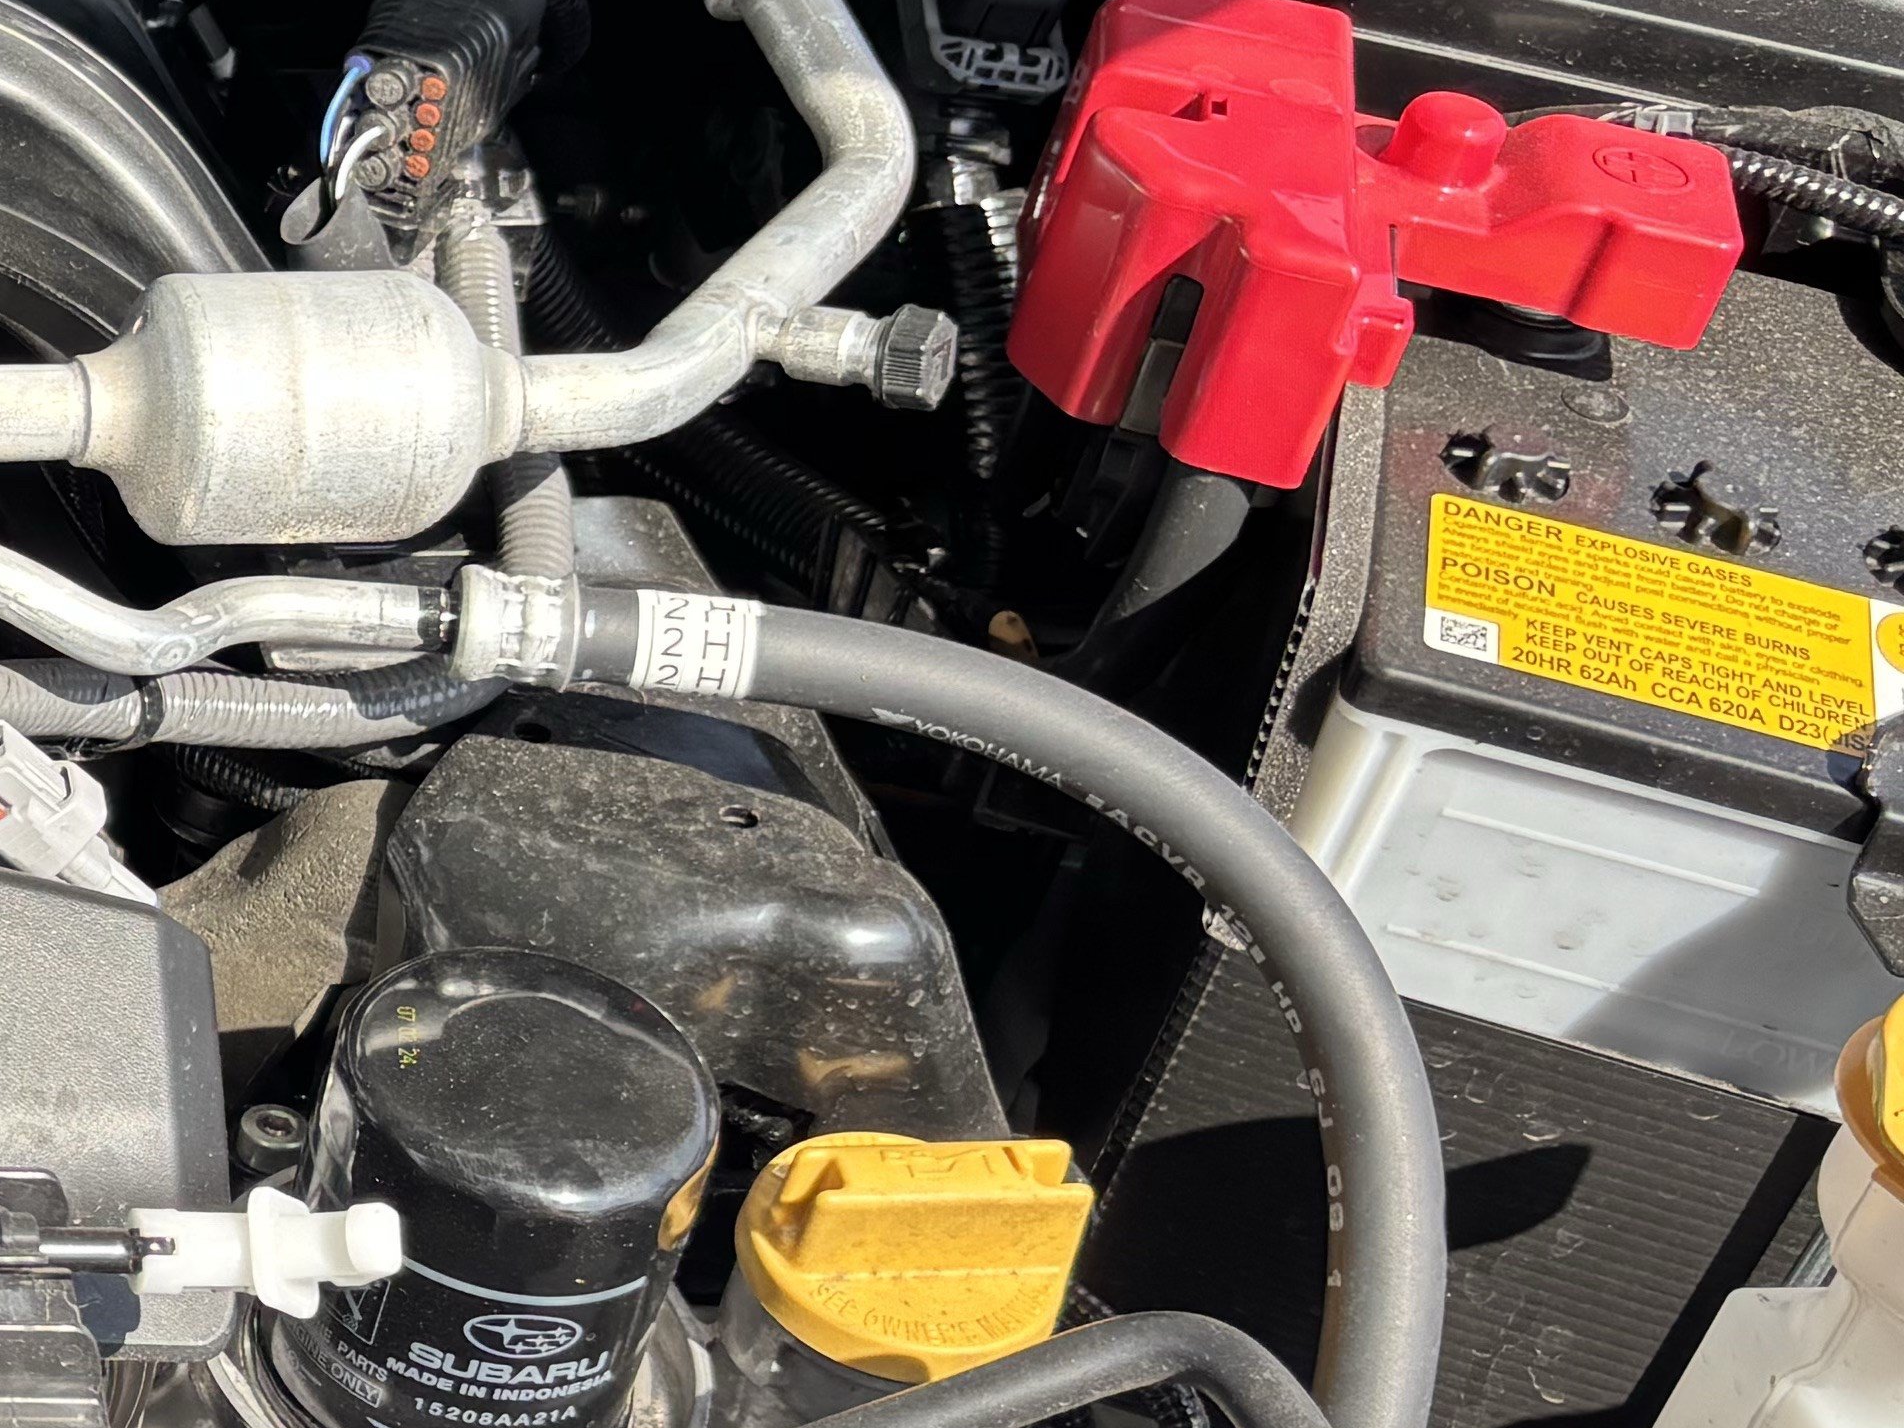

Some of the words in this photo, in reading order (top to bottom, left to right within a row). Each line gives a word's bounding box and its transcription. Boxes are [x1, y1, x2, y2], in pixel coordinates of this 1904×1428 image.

[1443, 499, 1562, 542] DANGER
[1575, 532, 1679, 572] EXPLOSIVE
[1687, 560, 1751, 590] GASES
[664, 597, 689, 620] 2
[1441, 554, 1555, 598] POISON
[1576, 588, 1653, 622] CAUSES
[1661, 609, 1737, 643] SEVERE
[1744, 630, 1810, 662] BURNS
[660, 627, 683, 657] 2
[702, 629, 731, 661] H
[1525, 616, 1576, 642] KEEP
[1583, 631, 1633, 656] VENT
[1639, 645, 1692, 671] CAPS
[1700, 660, 1755, 687] TIGHT
[1762, 676, 1802, 698] AND
[1809, 687, 1869, 715] LEVEL
[655, 664, 679, 686] 2
[695, 666, 726, 690] H
[1512, 645, 1572, 676] 20HR
[1579, 662, 1637, 692] 62Ah
[1650, 680, 1702, 708] CCA
[1709, 694, 1766, 724] 620A
[1525, 631, 1576, 656] KEEP
[1583, 646, 1620, 667] OUT
[1629, 657, 1654, 676] OF
[1662, 666, 1729, 694] REACH
[1736, 684, 1761, 702] OF
[1768, 692, 1866, 728] CHILDREN
[915, 719, 1062, 789] YOKOHAMA
[1271, 981, 1302, 1033] HP
[330, 1362, 383, 1401] ONLY
[336, 1340, 389, 1384] PARTS
[386, 1356, 454, 1392] MADE
[460, 1382, 487, 1399] IN
[492, 1369, 612, 1402] INDONESIA
[408, 1342, 609, 1386] SUBARU
[414, 1396, 578, 1428] 15208AA21A
